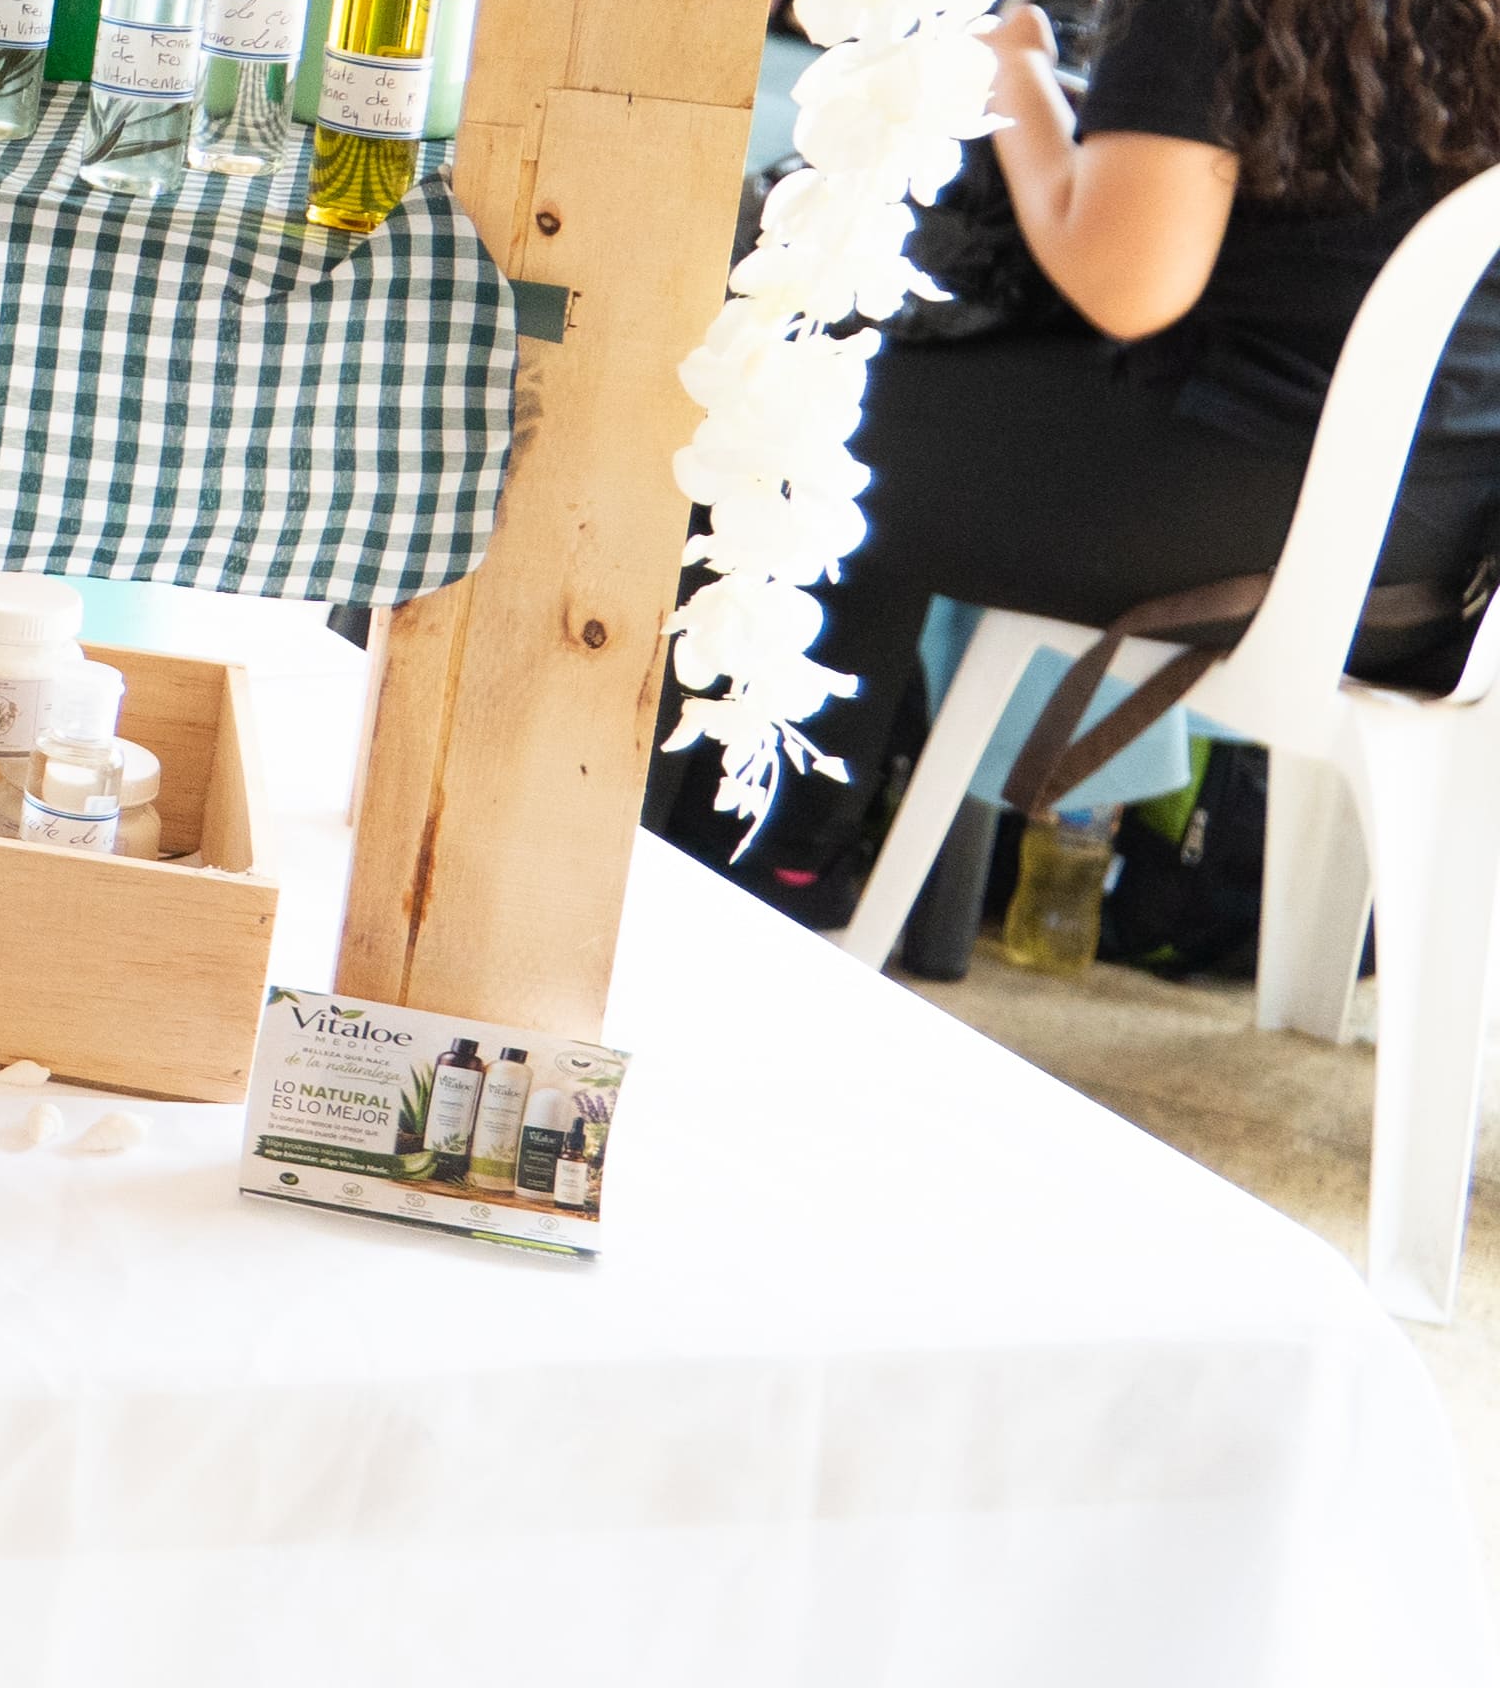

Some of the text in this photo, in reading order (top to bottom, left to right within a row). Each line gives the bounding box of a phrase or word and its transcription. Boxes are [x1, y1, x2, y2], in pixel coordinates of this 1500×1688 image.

[111, 28, 131, 45] de
[111, 47, 136, 64] de
[374, 70, 397, 90] de
[364, 90, 390, 106] de
[291, 1005, 413, 1047] Vitaloe
[315, 1035, 384, 1054] MEDIC
[326, 1060, 402, 1085] naturaleza
[274, 1079, 392, 1110] LO NATURAL
[271, 1094, 389, 1126] ES LO MEJOR
